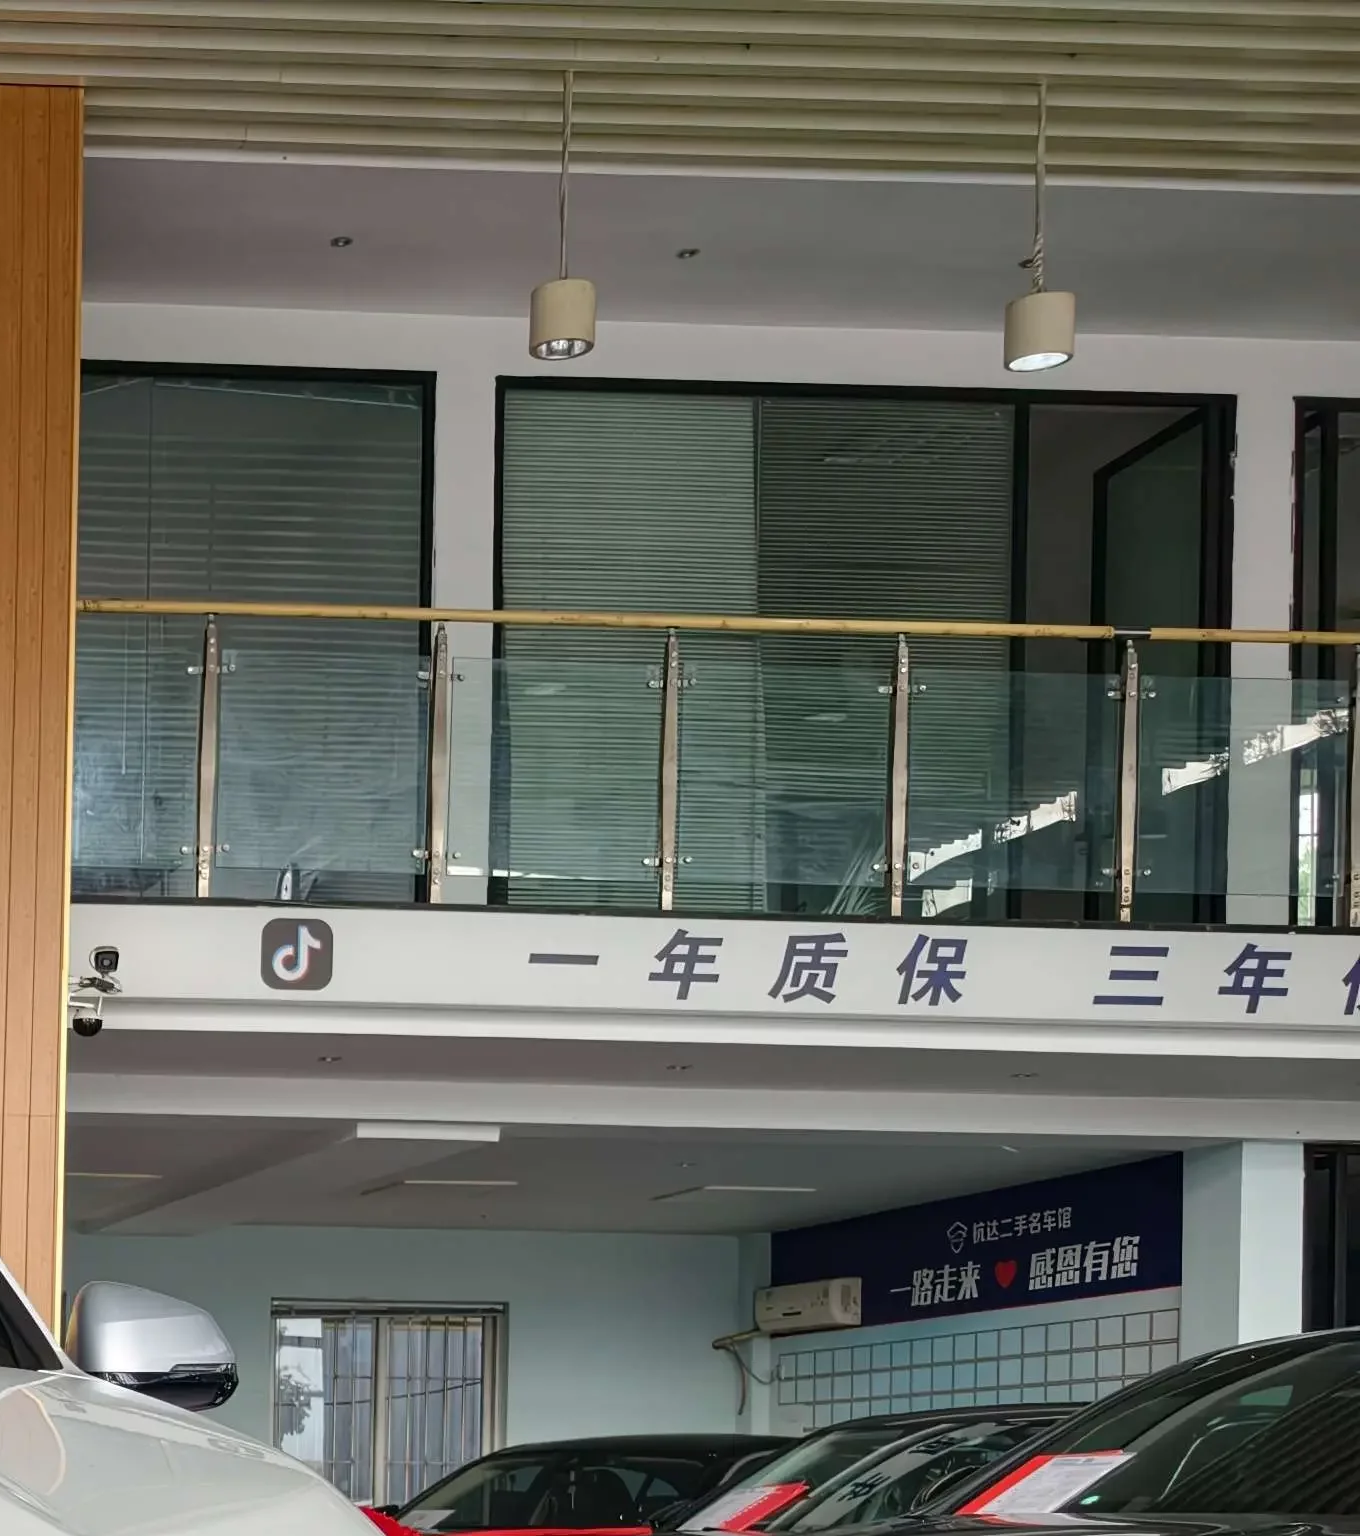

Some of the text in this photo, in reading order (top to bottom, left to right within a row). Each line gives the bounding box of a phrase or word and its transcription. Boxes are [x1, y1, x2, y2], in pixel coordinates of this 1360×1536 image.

[528, 928, 1360, 1016] 一年质保 三年
[972, 1206, 1073, 1245] 杭达二手名车馆
[890, 1235, 1141, 1307] 一路走来 感恩有您
